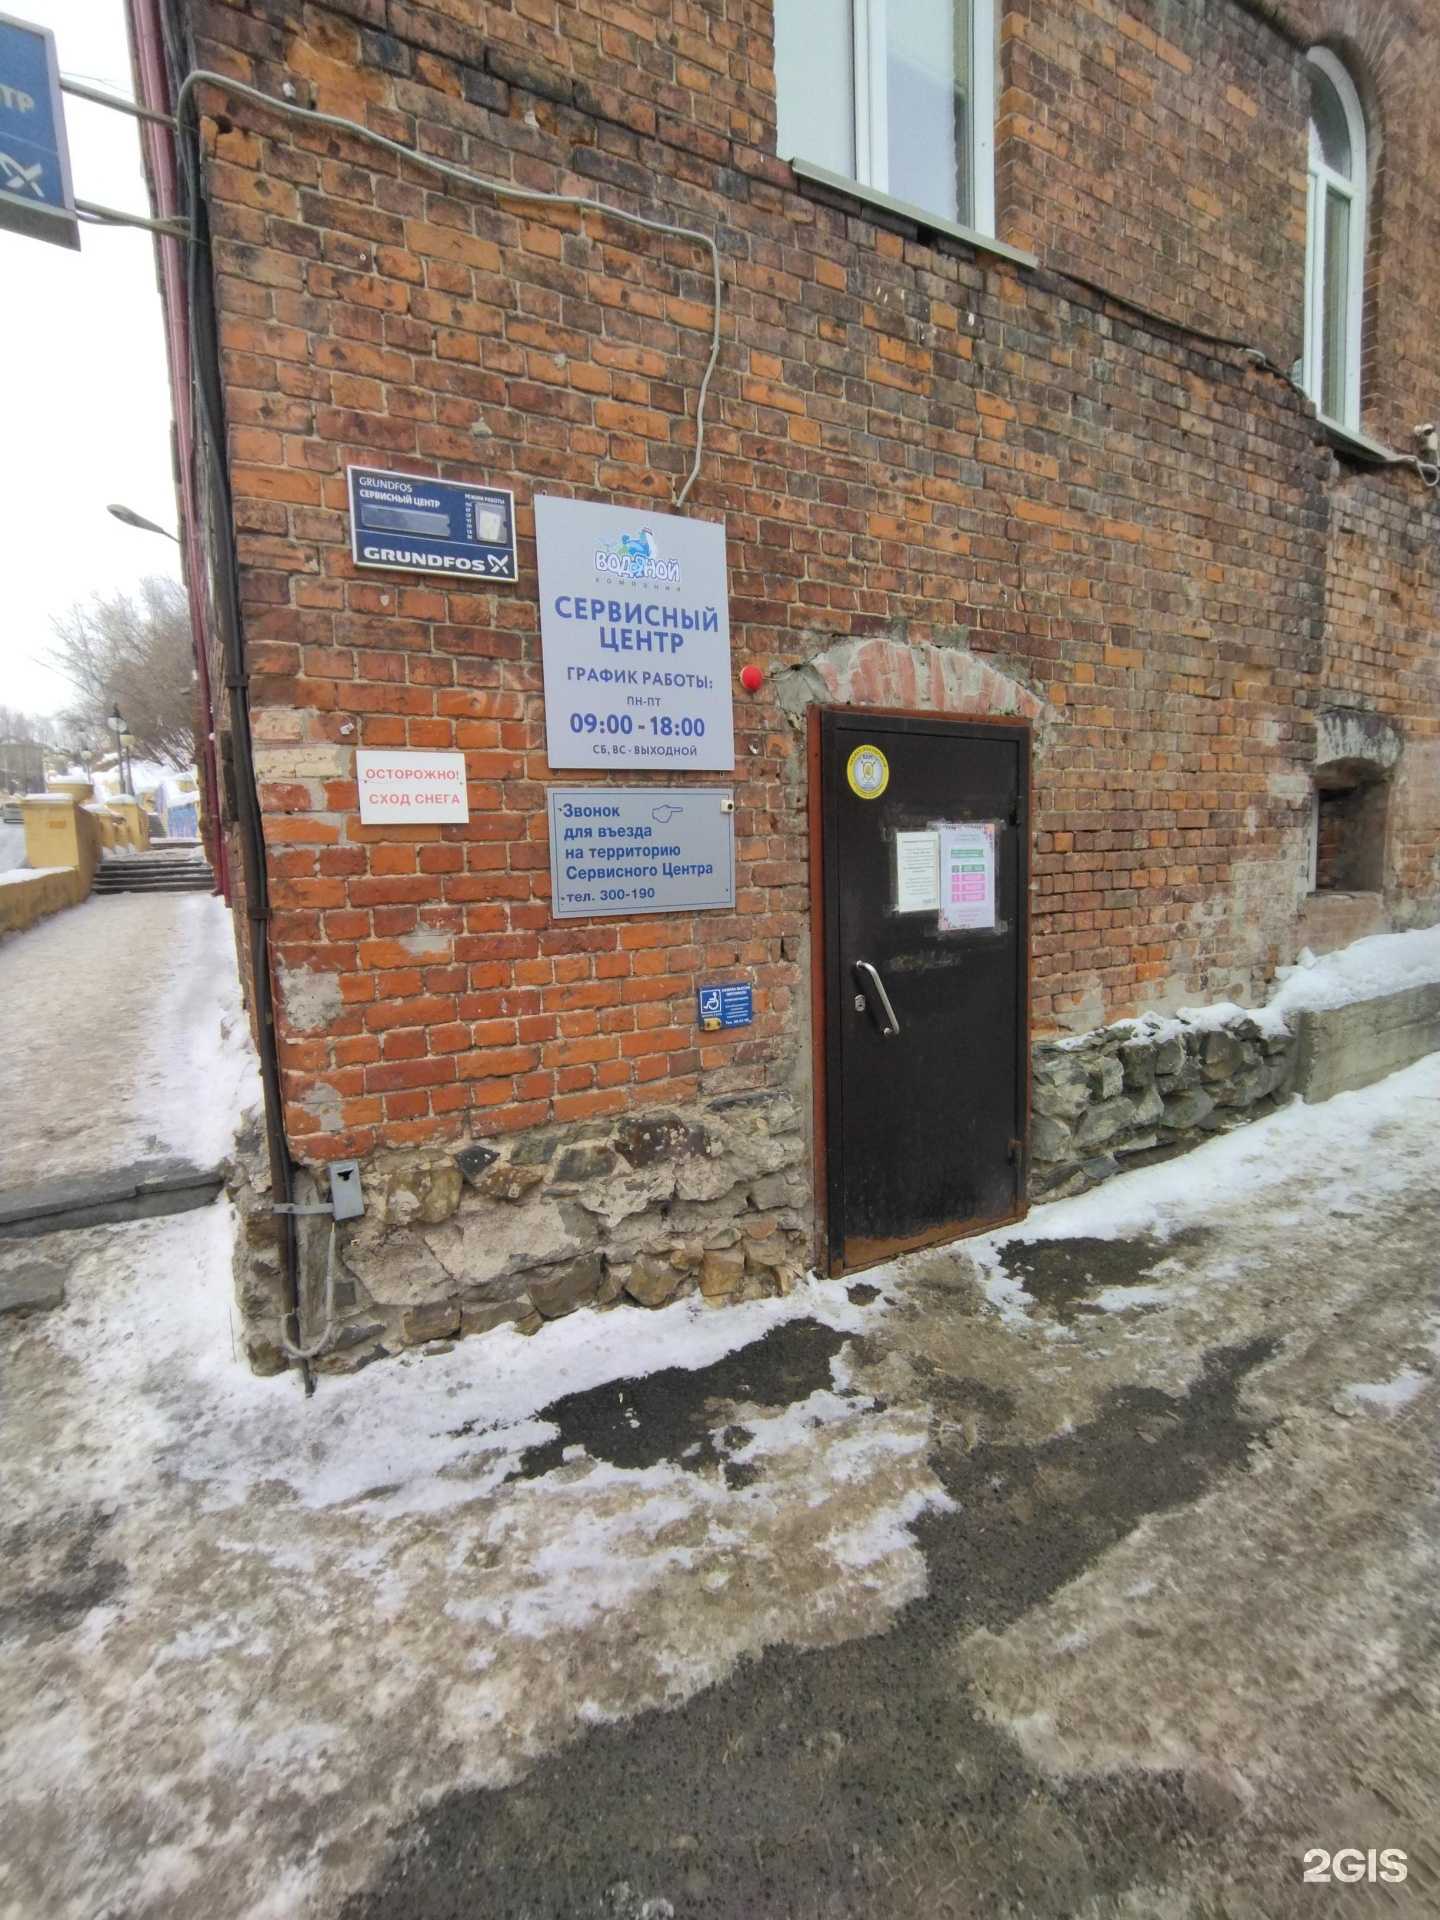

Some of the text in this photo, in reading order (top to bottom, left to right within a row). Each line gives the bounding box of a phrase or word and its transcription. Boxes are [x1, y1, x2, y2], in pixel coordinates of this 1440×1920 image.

[359, 476, 413, 493] GRUNDFOS
[359, 489, 441, 509] СЕРВИСНЫЙ ЦЕНТР
[363, 546, 486, 572] GRUNDFOS
[594, 550, 681, 582] ВОДЯНОЙ
[554, 595, 719, 633] СЕРВИСНЫЙ
[598, 626, 685, 654] ЦЕНТР
[566, 666, 713, 690] ГРАФИК РАБОТЫ:
[626, 695, 662, 706] ПН-ПТ
[569, 712, 633, 735] 09:00
[649, 716, 705, 737] 18:00
[592, 743, 611, 755] СБ,
[612, 744, 626, 755] ВС
[633, 743, 698, 757] ВЫХОДНОЙ
[365, 768, 460, 780] ОСТОРОЖНО!
[368, 793, 461, 806] СХОД СНЕГА
[562, 803, 620, 818] Звонок
[563, 825, 652, 841] для въезда
[565, 845, 681, 861] на территорию
[566, 862, 713, 882] Сервисного Центра
[566, 887, 656, 903] тел. 300-190
